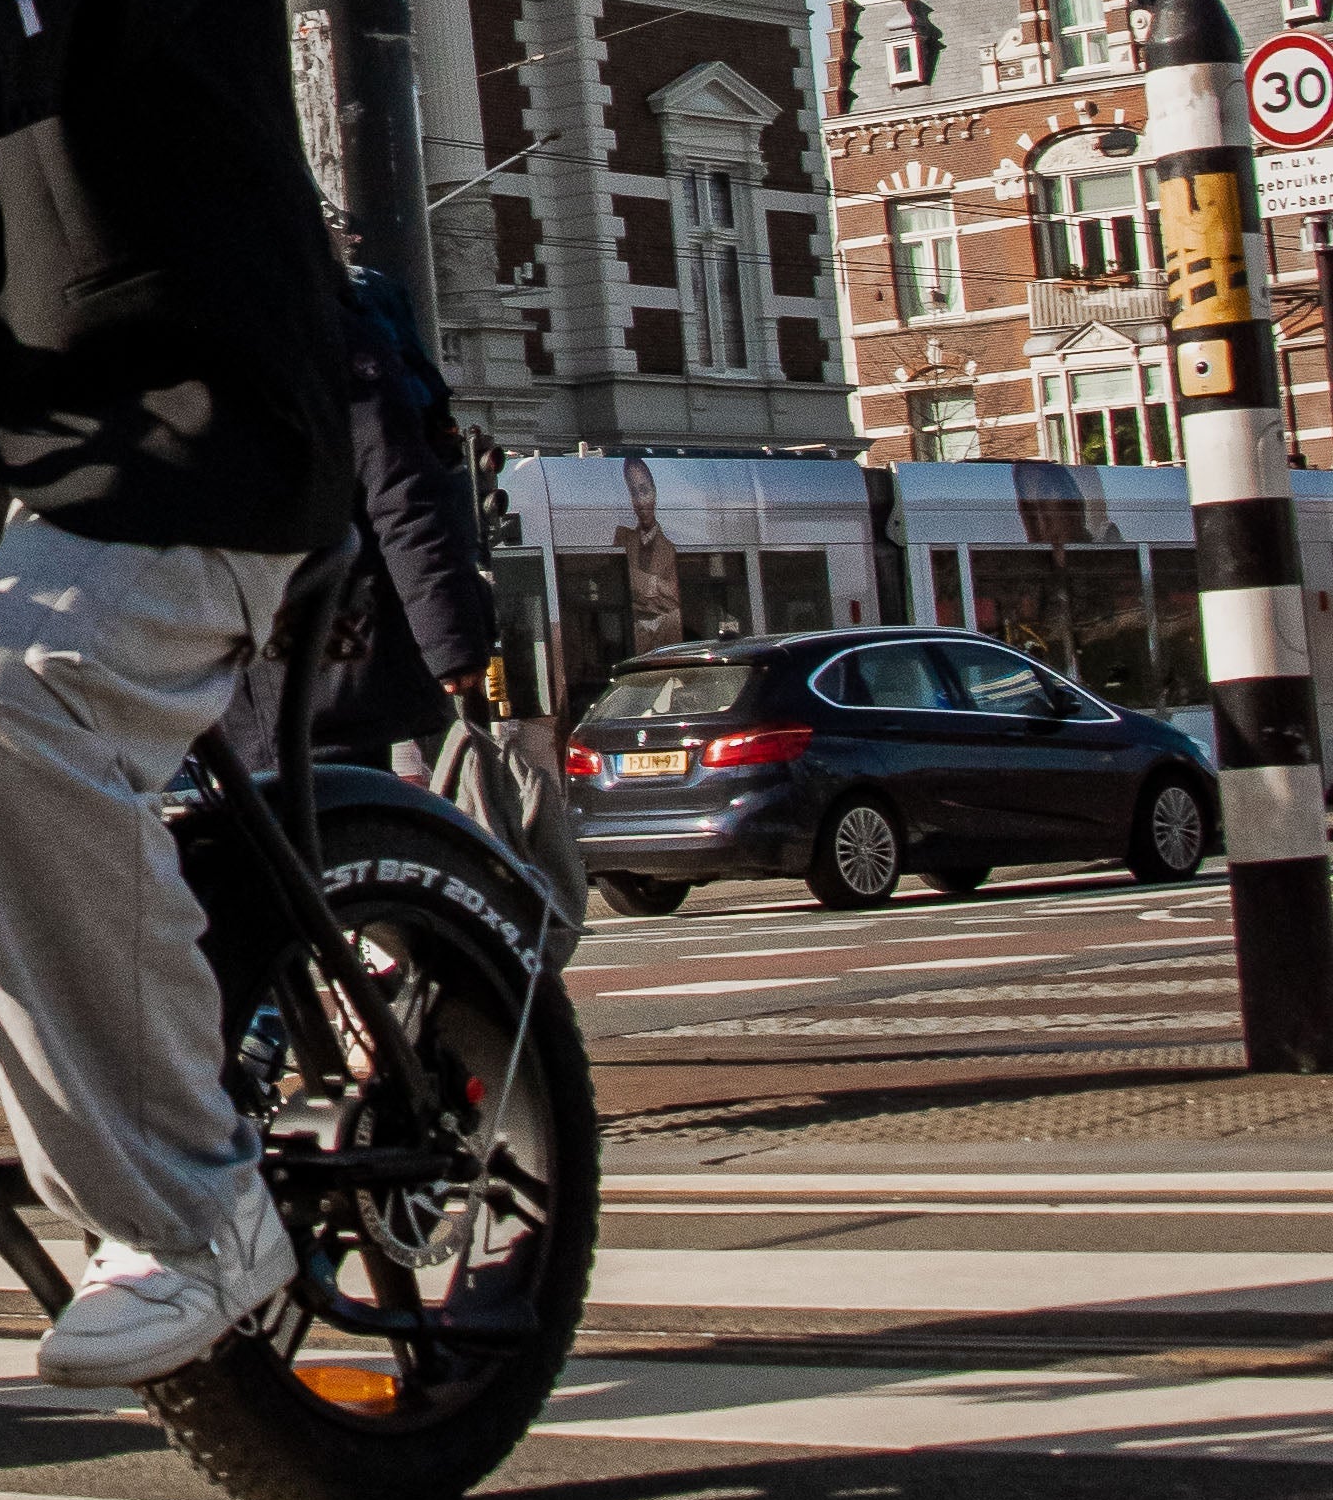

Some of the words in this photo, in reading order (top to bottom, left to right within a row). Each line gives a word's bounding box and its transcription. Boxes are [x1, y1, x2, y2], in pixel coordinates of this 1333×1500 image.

[1260, 66, 1327, 114] 30
[1270, 156, 1321, 171] m.u.v.
[377, 859, 441, 888] BFT
